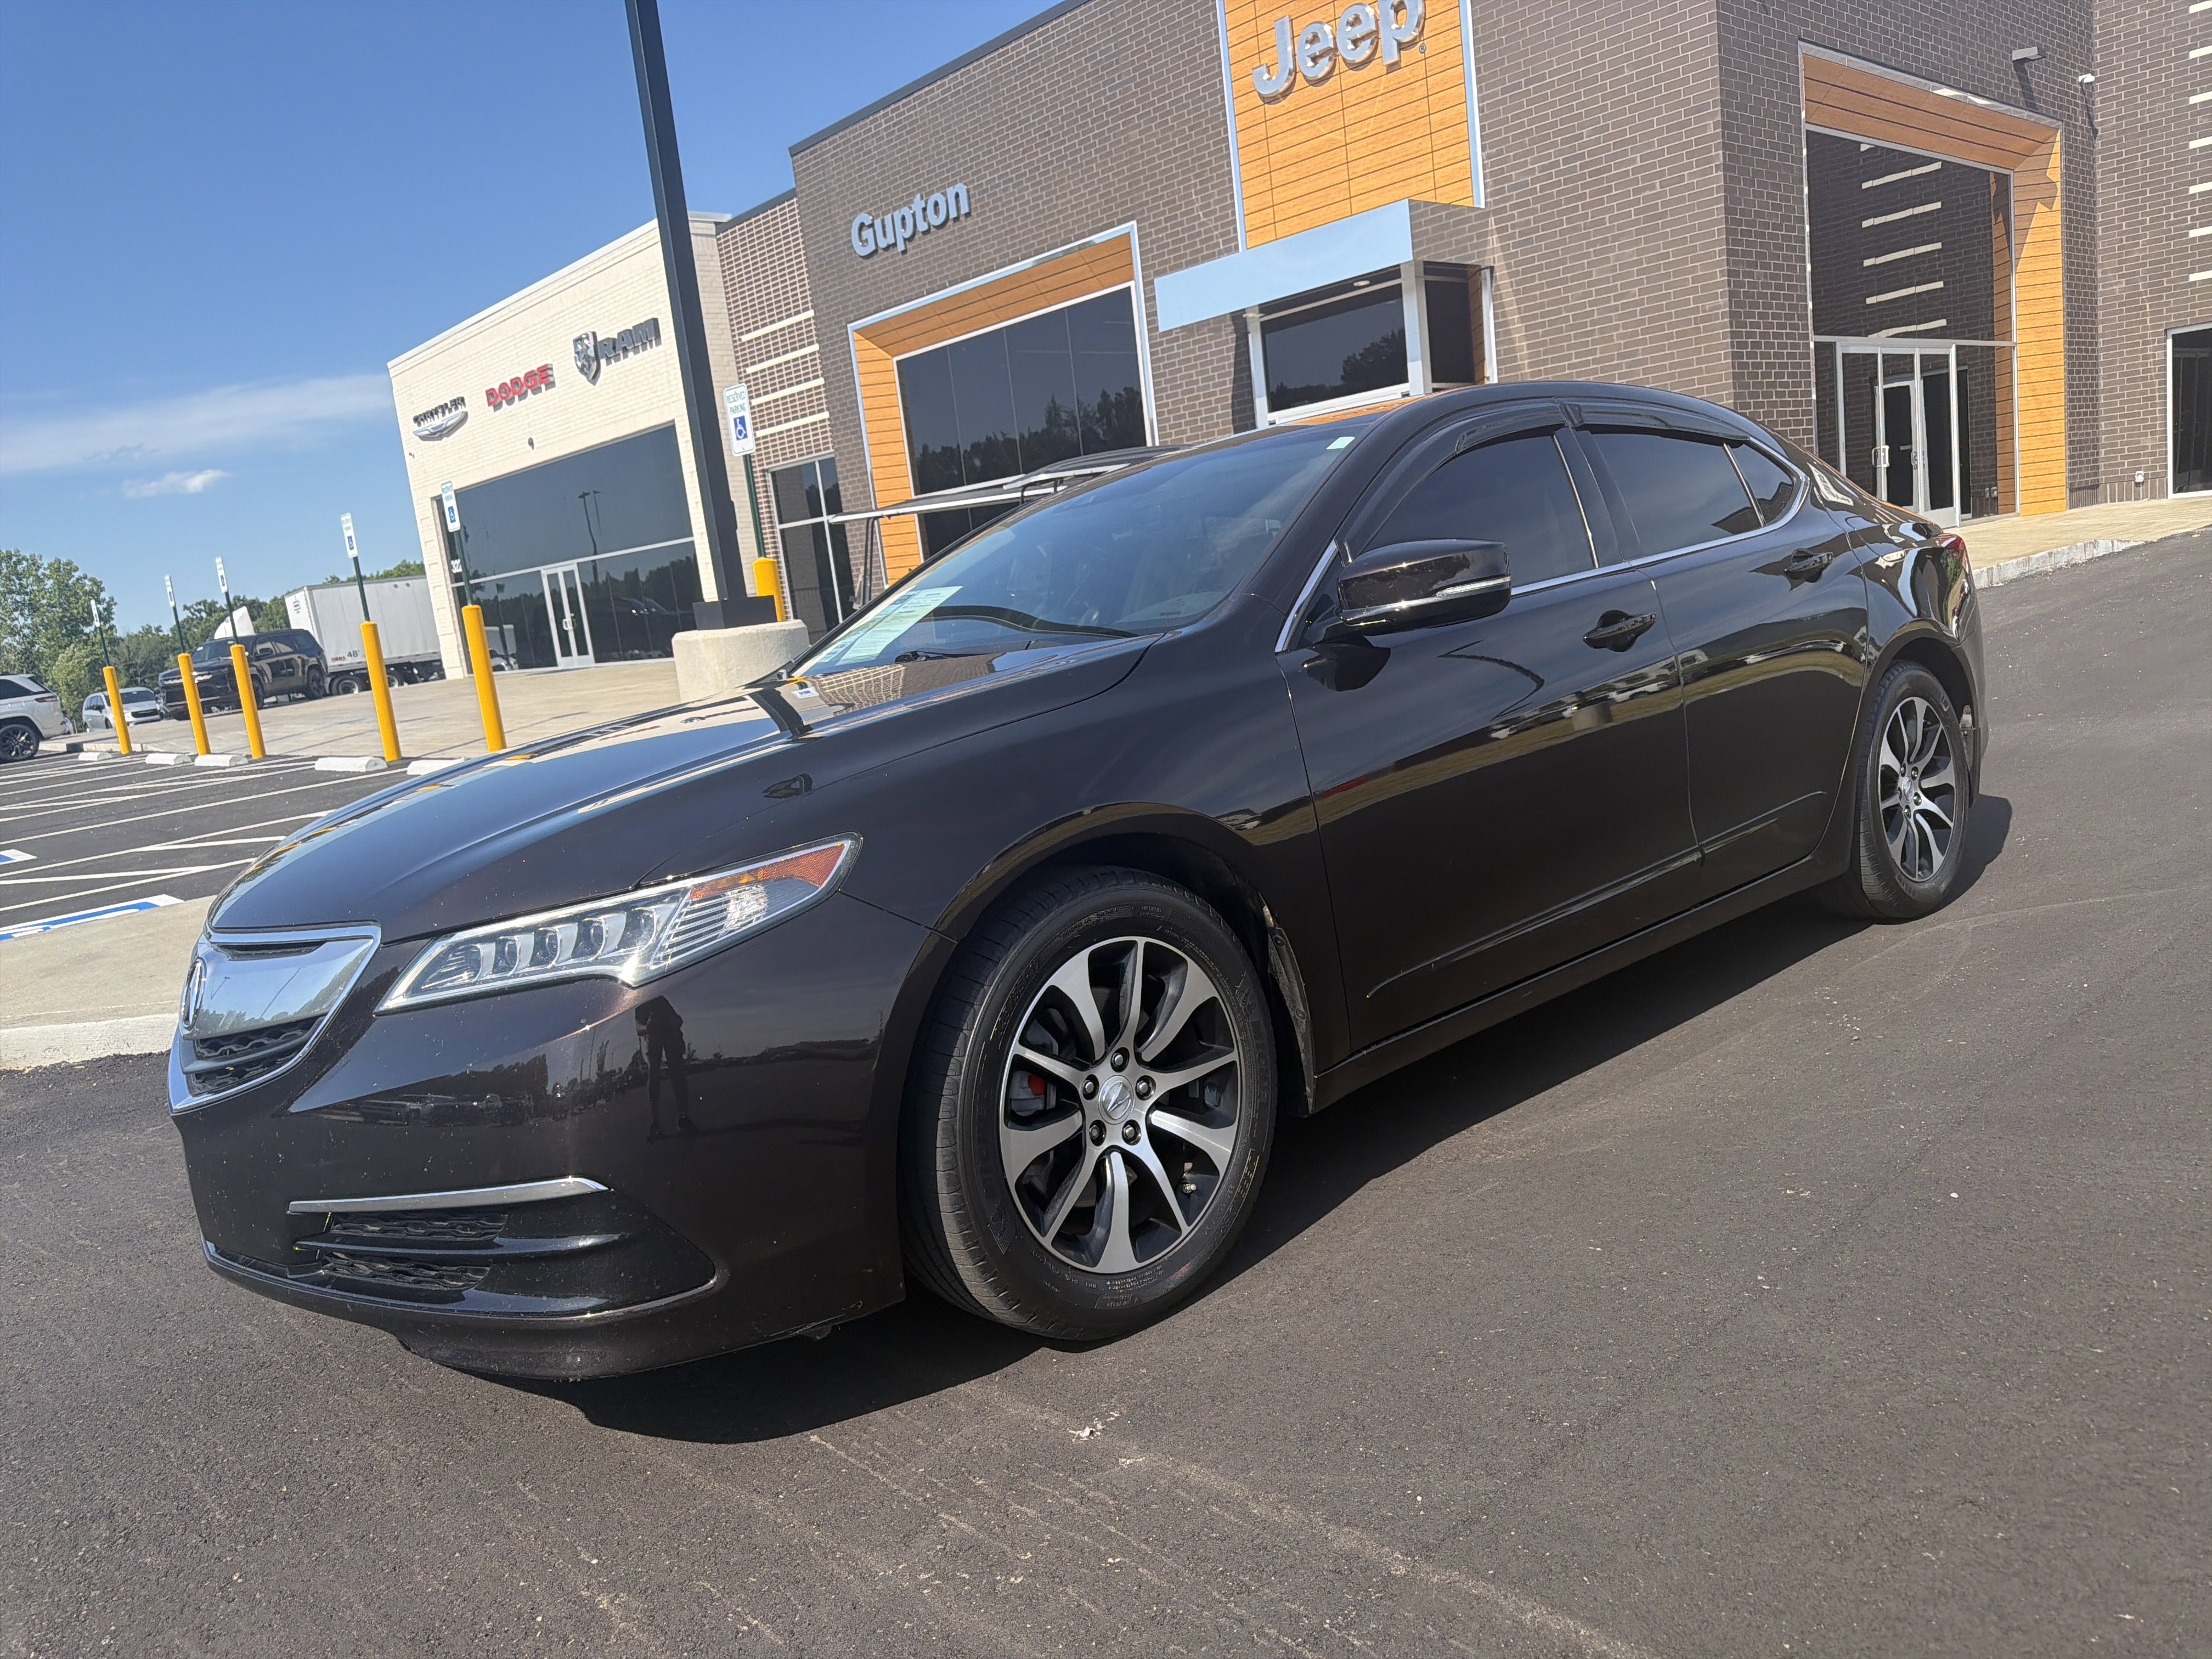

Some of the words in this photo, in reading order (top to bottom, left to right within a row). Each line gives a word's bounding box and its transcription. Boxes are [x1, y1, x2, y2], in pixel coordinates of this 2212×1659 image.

[1252, 0, 1426, 97] Jeep
[851, 182, 970, 256] Gupton
[597, 317, 659, 360] RAM
[485, 363, 552, 407] DODGE
[413, 396, 466, 426] CHRYSLER
